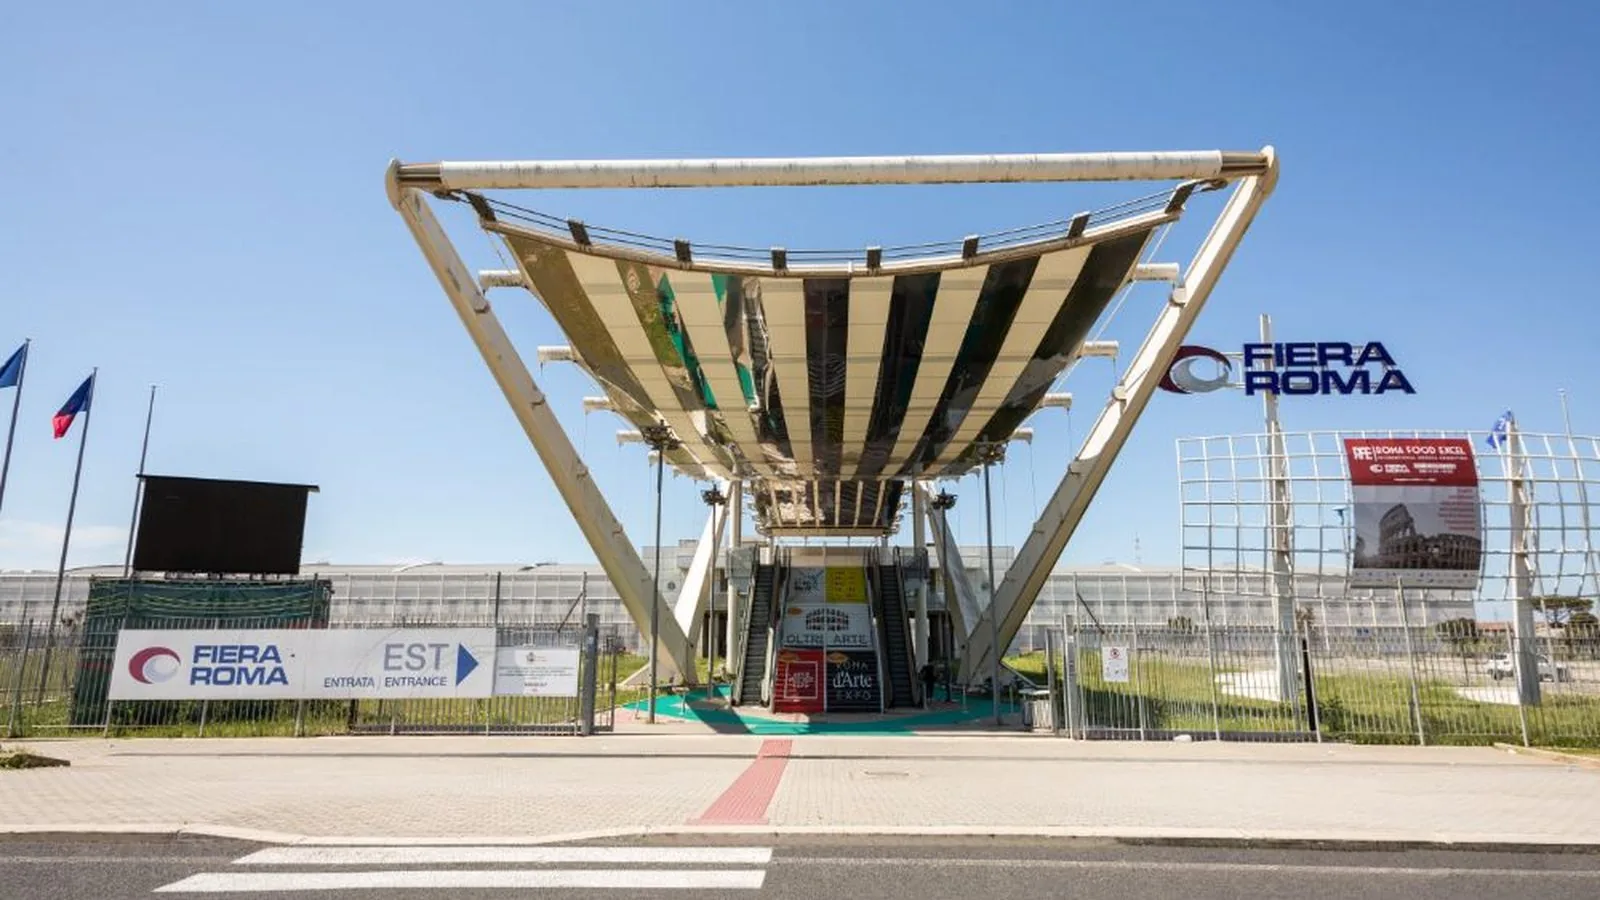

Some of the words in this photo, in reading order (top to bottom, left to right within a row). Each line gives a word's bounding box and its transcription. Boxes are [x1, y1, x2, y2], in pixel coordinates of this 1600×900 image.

[1244, 342, 1396, 366] FIERA
[1245, 370, 1416, 395] ROMA
[1375, 446, 1404, 454] ROMA
[1406, 446, 1436, 454] FOOD
[1437, 446, 1467, 455] EXCEL
[193, 645, 281, 663] FIERA
[383, 643, 449, 671] EST
[190, 667, 289, 685] ROMA
[324, 677, 374, 688] ENTRATA
[384, 676, 447, 687] ENTRANCE
